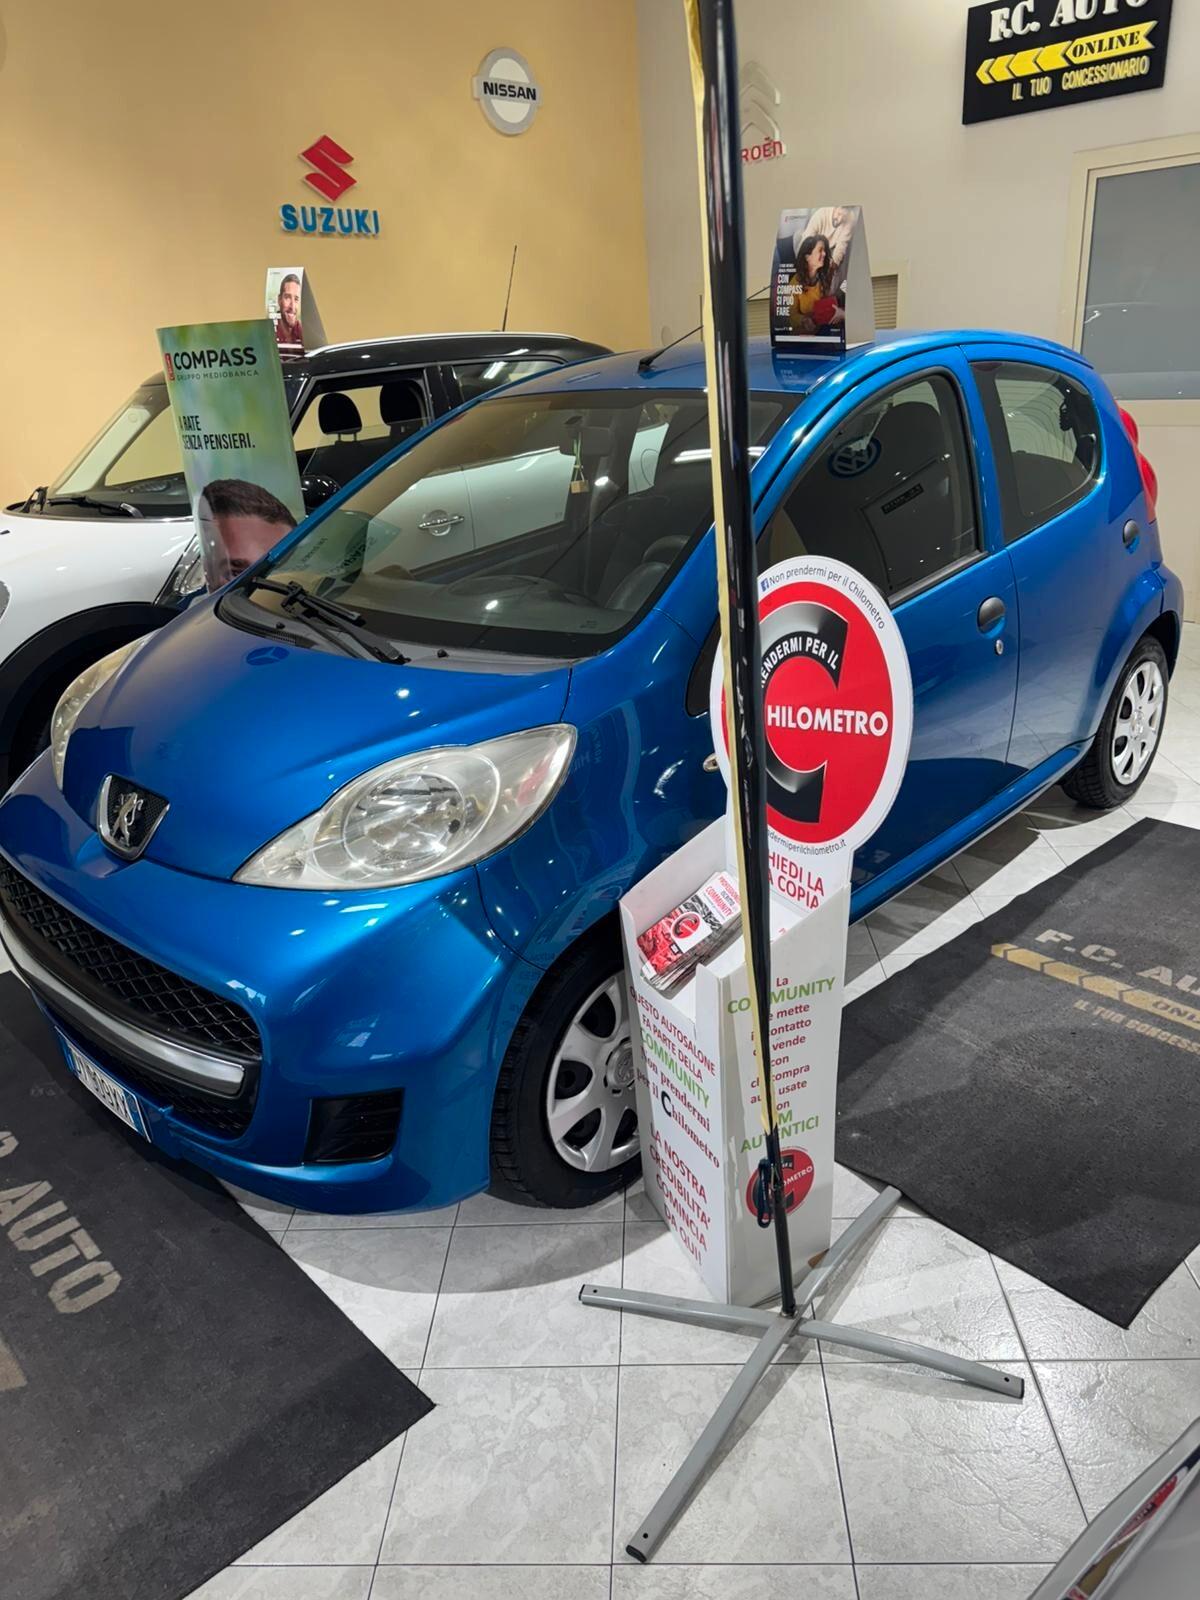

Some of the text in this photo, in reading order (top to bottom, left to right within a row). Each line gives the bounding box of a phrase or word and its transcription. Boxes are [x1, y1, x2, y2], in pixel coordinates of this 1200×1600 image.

[1050, 0, 1147, 27] AU
[1072, 31, 1140, 58] ONLINE
[483, 81, 537, 101] NISSAN
[1012, 55, 1149, 101] IL TUO CONCESSIONARIO
[741, 136, 784, 163] ROËN
[280, 204, 380, 235] SUZUKI
[776, 284, 803, 295] COMPASS
[777, 274, 790, 284] CON
[776, 306, 791, 316] FARE
[173, 346, 257, 371] COMPASS
[203, 369, 259, 380] MEDIOBANCA
[184, 415, 202, 431] RATE
[182, 432, 256, 450] SENZA PENSIERI.
[769, 565, 886, 630] Non prendermi per il Chilometro
[805, 637, 828, 660] PER
[828, 649, 839, 670] IL
[768, 851, 804, 883] HIEDI
[807, 871, 825, 897] LA
[704, 886, 733, 916] COMMUNITY
[727, 976, 836, 1014] COMUNITY
[776, 977, 789, 988] La
[776, 1003, 811, 1019] mette
[630, 985, 716, 1077] QUESTO AUTOSALONE
[770, 1019, 811, 1036] ontatto
[772, 1034, 807, 1051] vende
[1073, 999, 1090, 1012] IL
[1125, 1018, 1200, 1057] CONCESS
[642, 1013, 704, 1083] FA PARTE DELLA
[640, 1026, 710, 1109] COMMUNITY
[660, 1070, 711, 1132] prendermi
[778, 1080, 808, 1096] usate
[637, 1066, 721, 1169] per il Chilometro
[776, 1100, 791, 1111] on
[741, 1115, 820, 1153] AUNTICI
[650, 1122, 708, 1204] LA NOSTRA
[650, 1144, 711, 1230] CREDIBILITA'
[656, 1173, 708, 1252] COMINCIA
[0, 1180, 122, 1314] AUTO
[664, 1203, 703, 1265] DA QUI!
